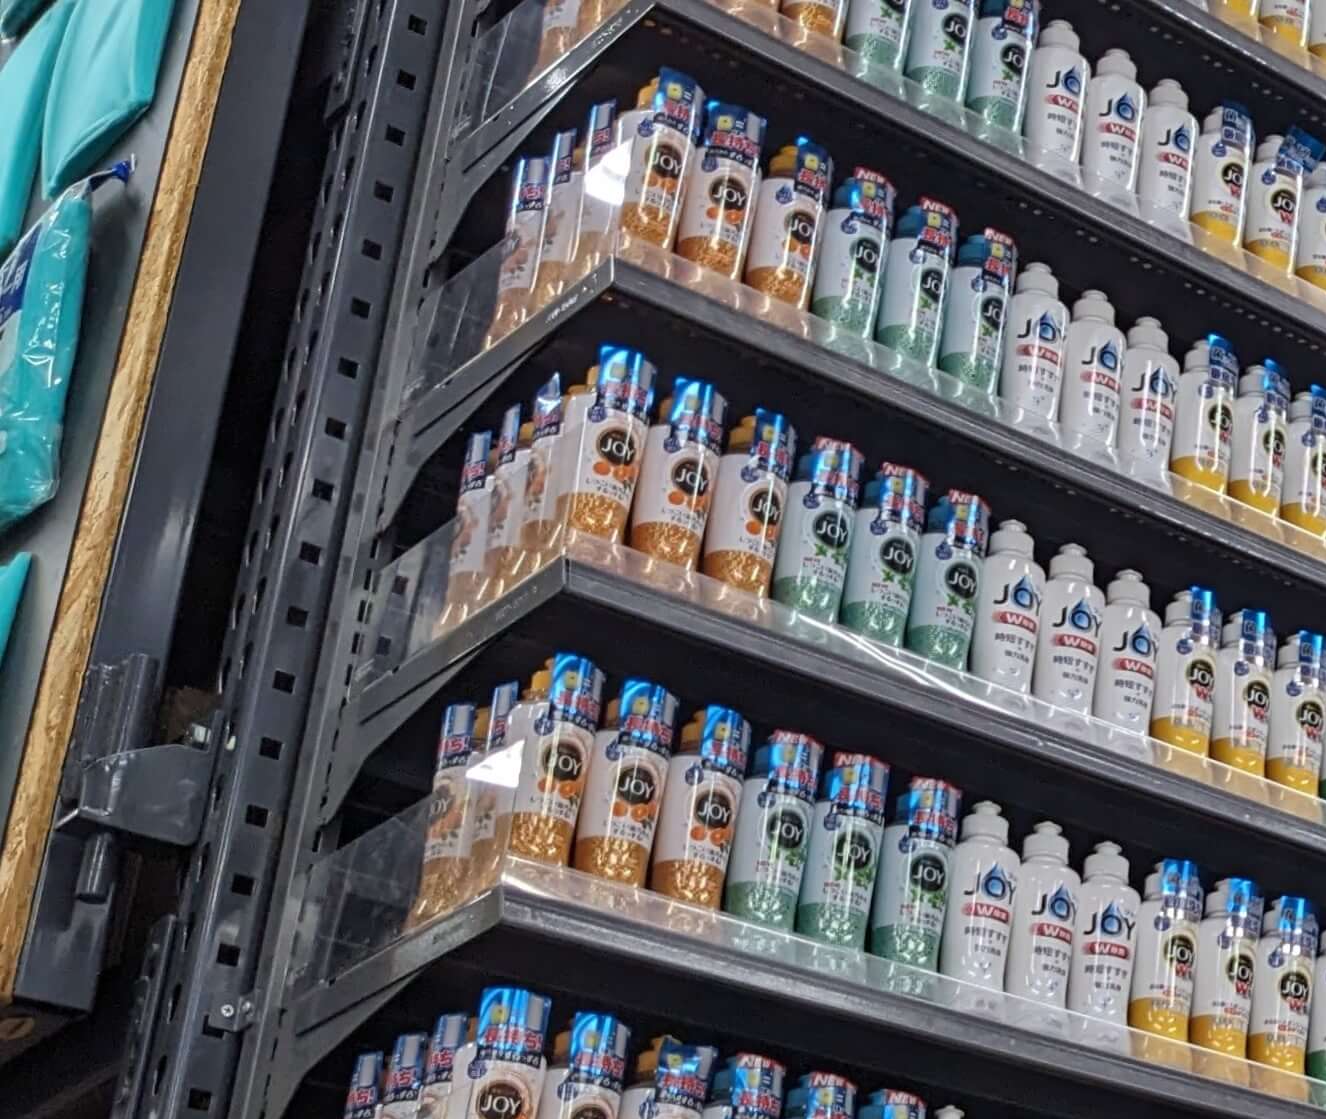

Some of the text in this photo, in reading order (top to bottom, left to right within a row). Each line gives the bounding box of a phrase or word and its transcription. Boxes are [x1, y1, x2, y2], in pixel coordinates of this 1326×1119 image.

[649, 149, 682, 176] JOY
[711, 184, 746, 207] JOY
[600, 437, 635, 460] JOY
[675, 469, 709, 492] JOY
[752, 494, 781, 517] JOY
[816, 519, 850, 543] JOY
[882, 542, 914, 565] JOY
[947, 567, 977, 591] JOY
[546, 751, 582, 777] JOY
[617, 775, 656, 799] JOY
[697, 798, 733, 823] JOY
[770, 819, 803, 841] JOY
[837, 840, 873, 865] JOY
[913, 859, 945, 885] JOY
[963, 869, 1016, 905] JOY
[1084, 907, 1135, 940] JOY
[481, 1095, 521, 1115] JOY
